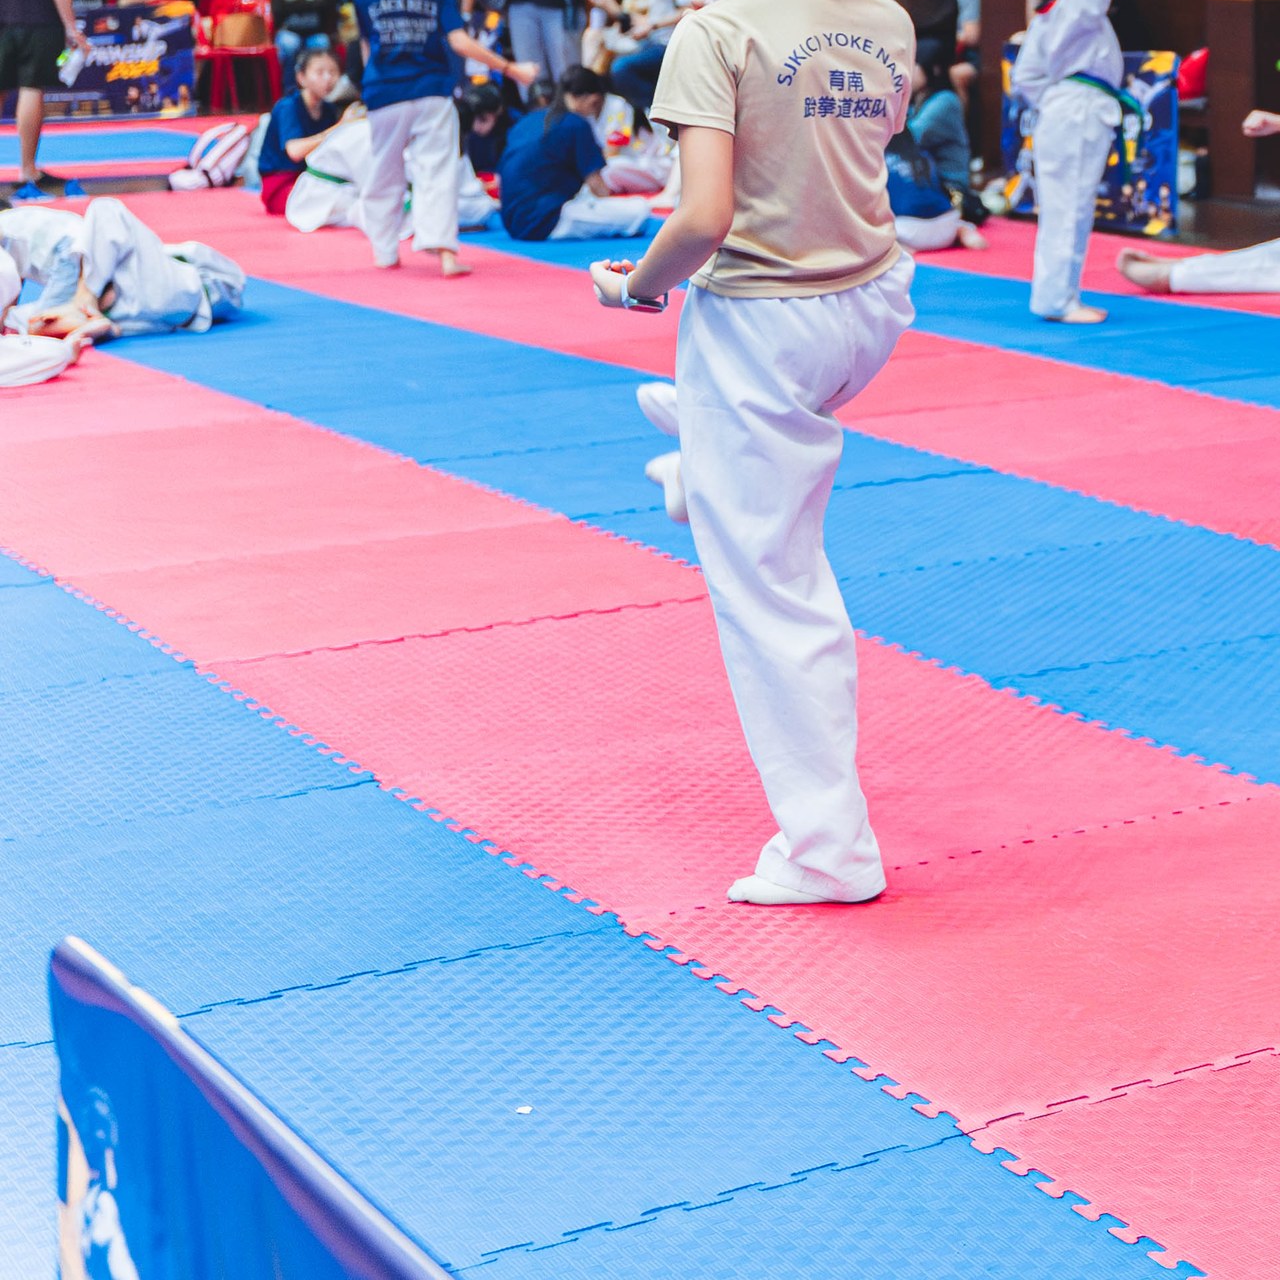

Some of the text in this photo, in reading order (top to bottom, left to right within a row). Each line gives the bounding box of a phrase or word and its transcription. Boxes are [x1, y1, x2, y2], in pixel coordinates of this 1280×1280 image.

[777, 35, 822, 87] SJK(C)
[823, 32, 874, 54] YOKE
[829, 69, 865, 93] 育南
